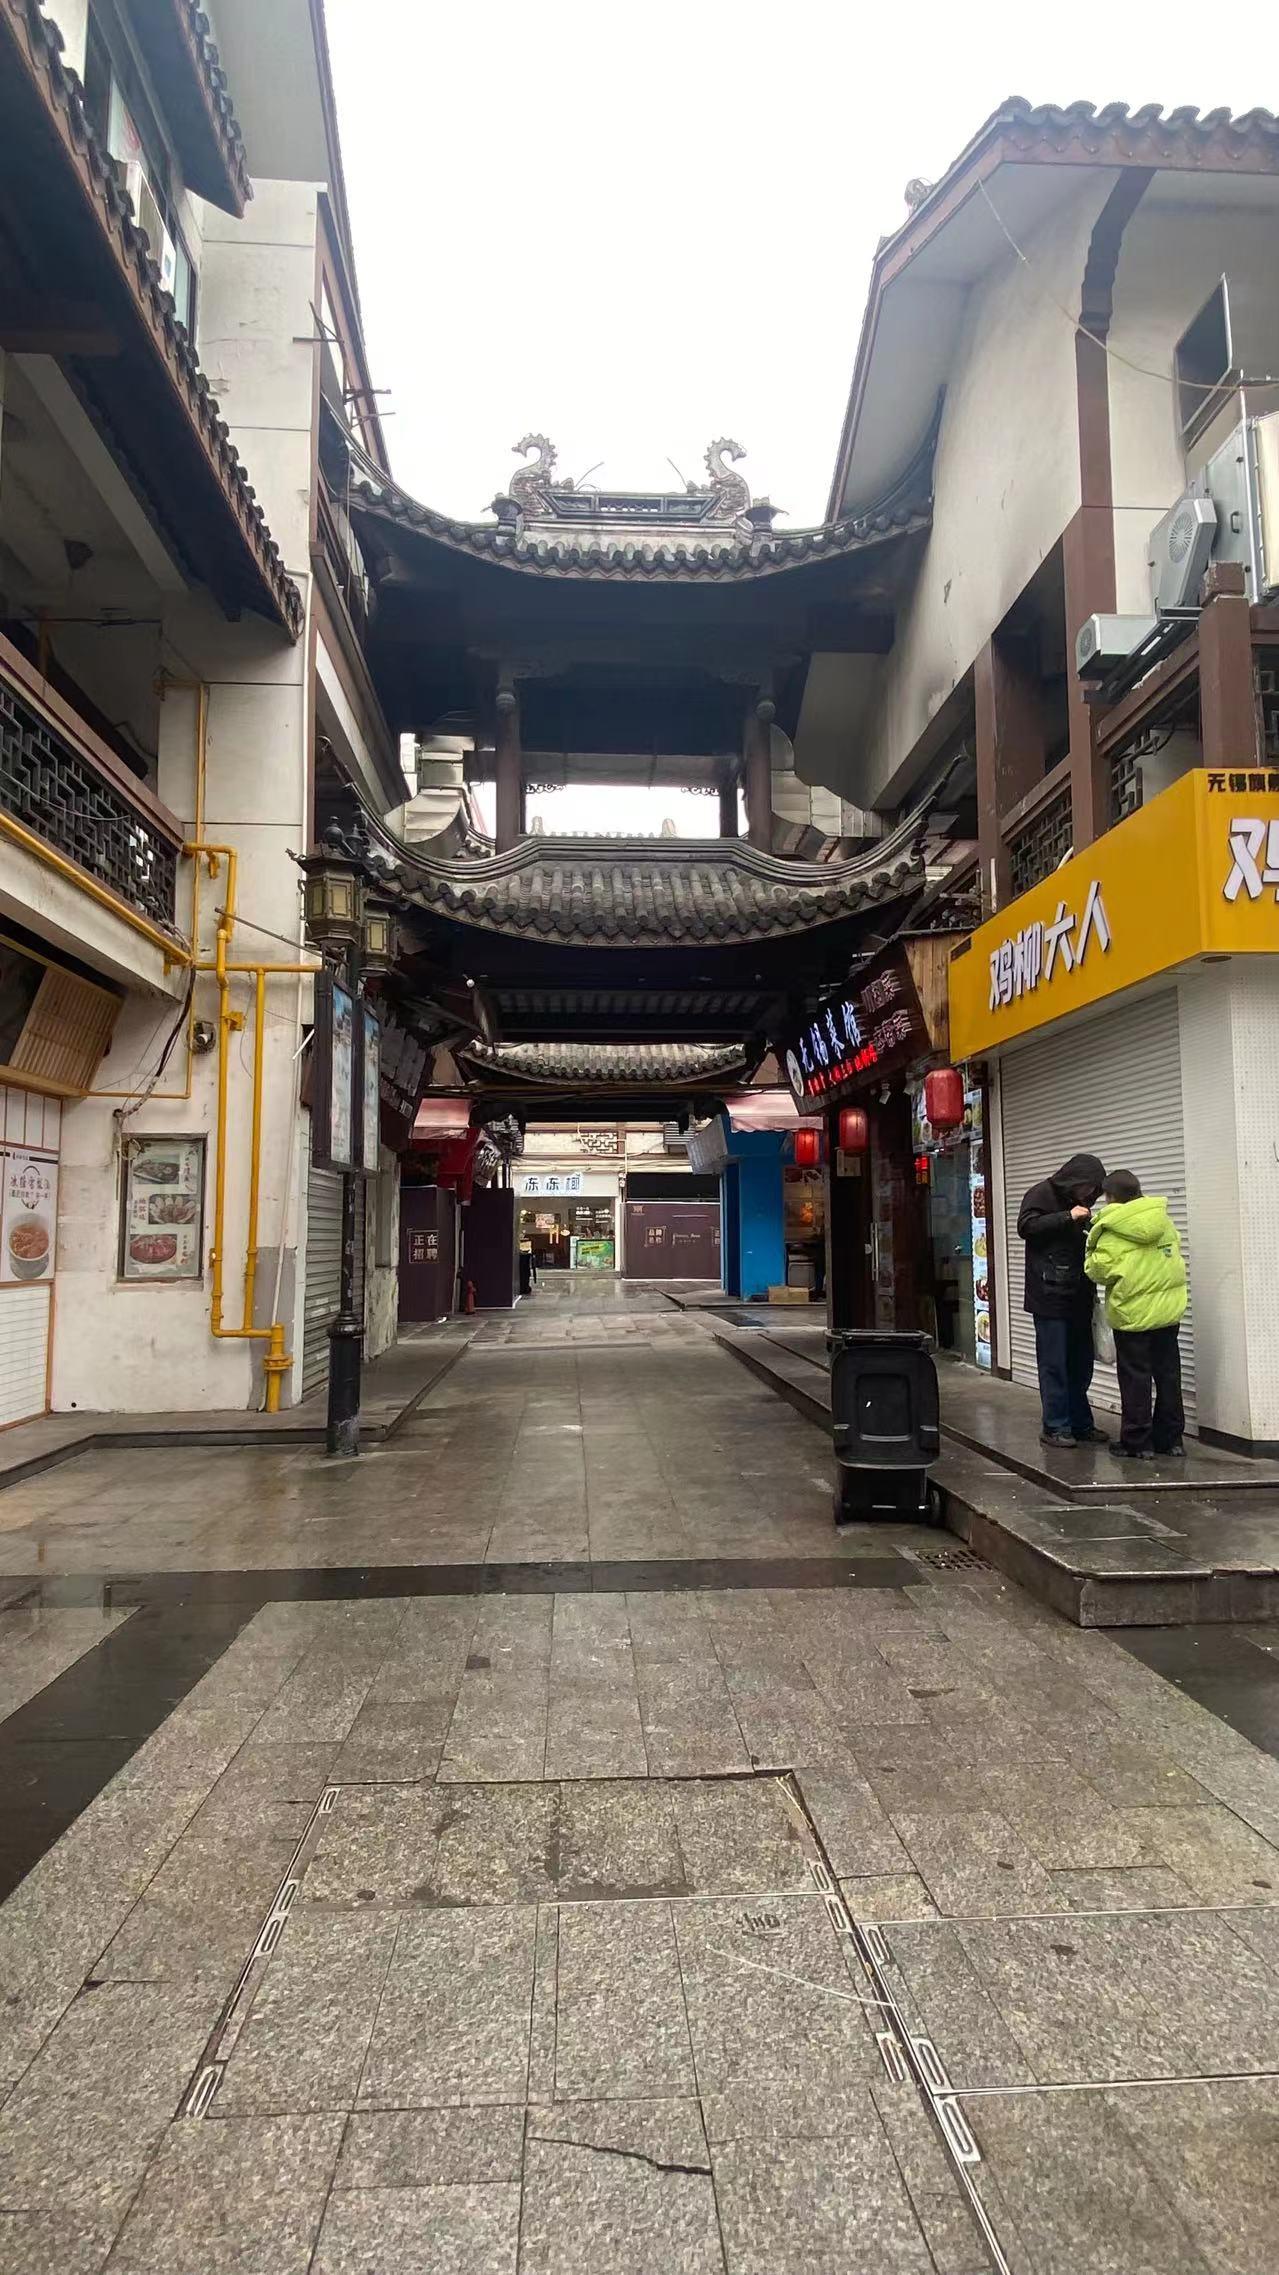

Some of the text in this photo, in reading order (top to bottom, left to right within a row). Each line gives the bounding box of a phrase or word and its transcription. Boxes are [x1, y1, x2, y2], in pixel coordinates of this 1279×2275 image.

[988, 880, 1112, 1012] 鸡柳大人
[413, 1233, 438, 1246] 正在
[413, 1247, 438, 1261] 招聘
